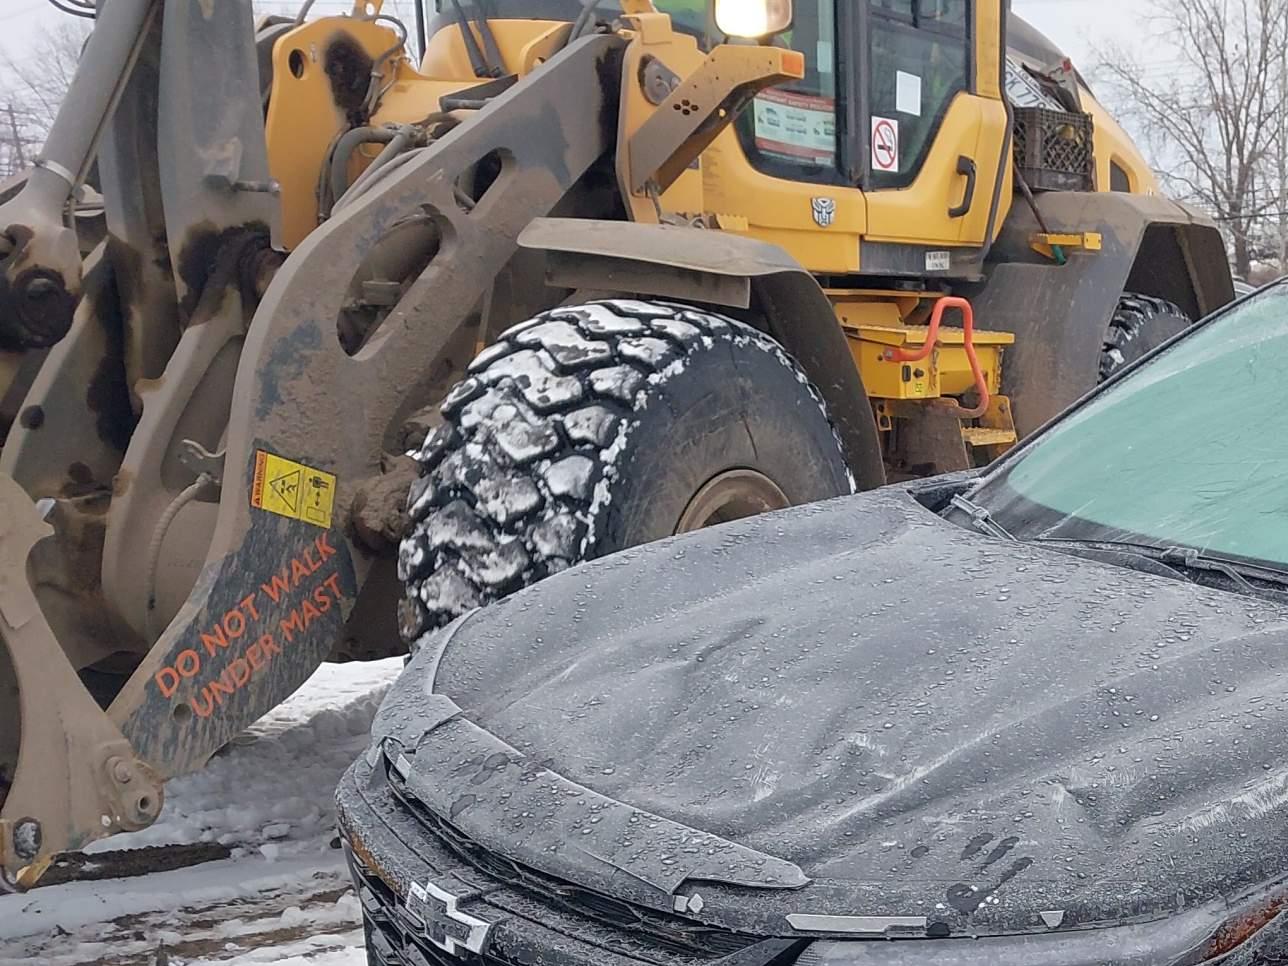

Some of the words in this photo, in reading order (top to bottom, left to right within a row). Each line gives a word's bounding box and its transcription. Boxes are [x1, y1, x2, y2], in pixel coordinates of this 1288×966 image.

[155, 649, 200, 698] DO
[200, 593, 259, 656] NOT
[261, 531, 336, 604] WALK
[191, 634, 281, 718] UNDER
[280, 572, 344, 641] MAST
